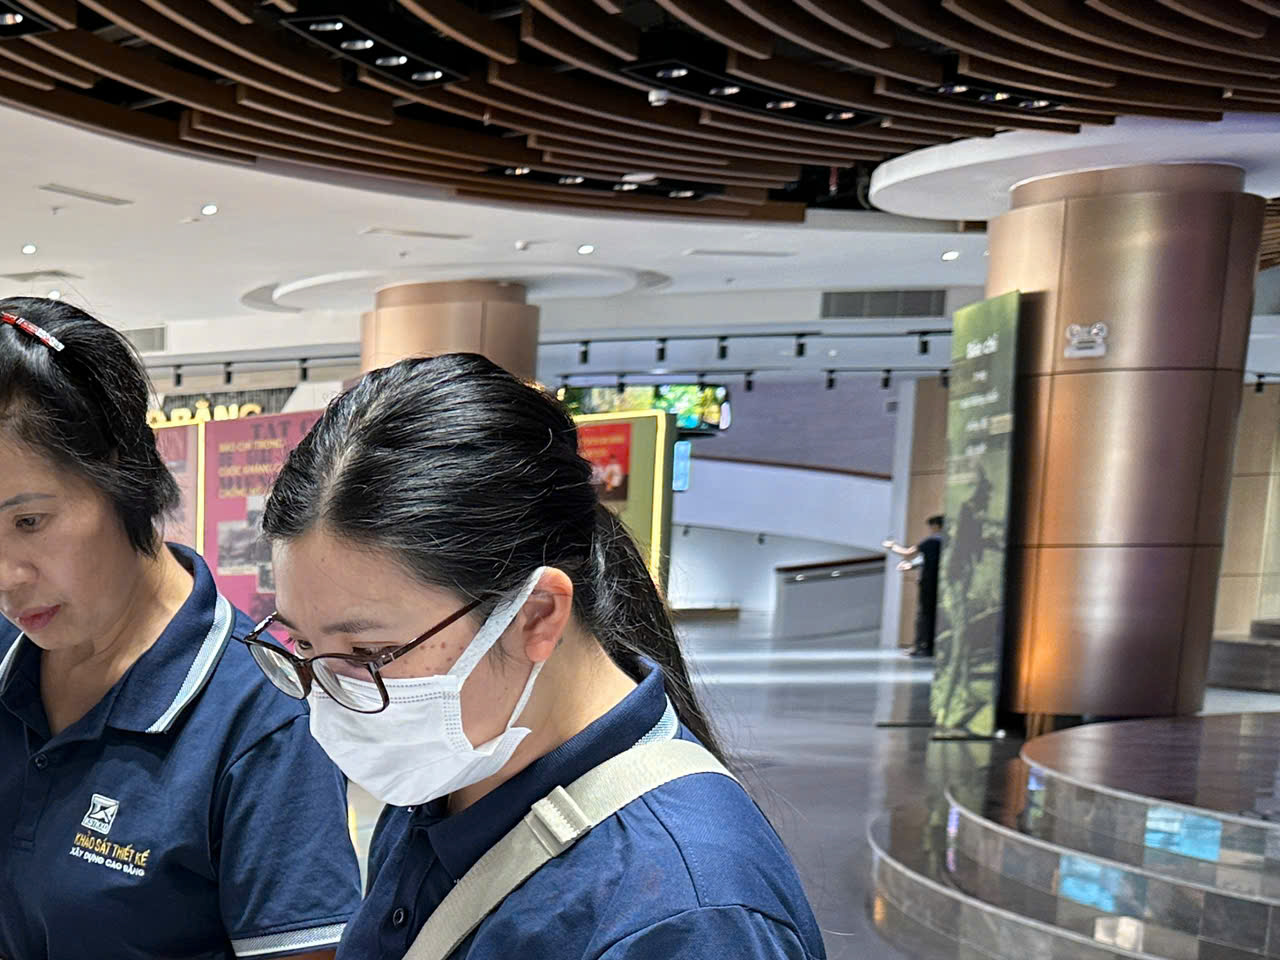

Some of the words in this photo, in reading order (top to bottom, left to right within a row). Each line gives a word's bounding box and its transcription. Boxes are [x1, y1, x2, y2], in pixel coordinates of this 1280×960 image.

[70, 847, 83, 858] XÂY
[83, 851, 104, 865] DỰNG
[105, 858, 122, 871] CAO
[123, 863, 145, 877] BẰNG
[74, 830, 95, 850] KHẢO
[95, 838, 112, 855] SÁT
[112, 843, 135, 863] THIẾT
[135, 849, 150, 866] KẾ
